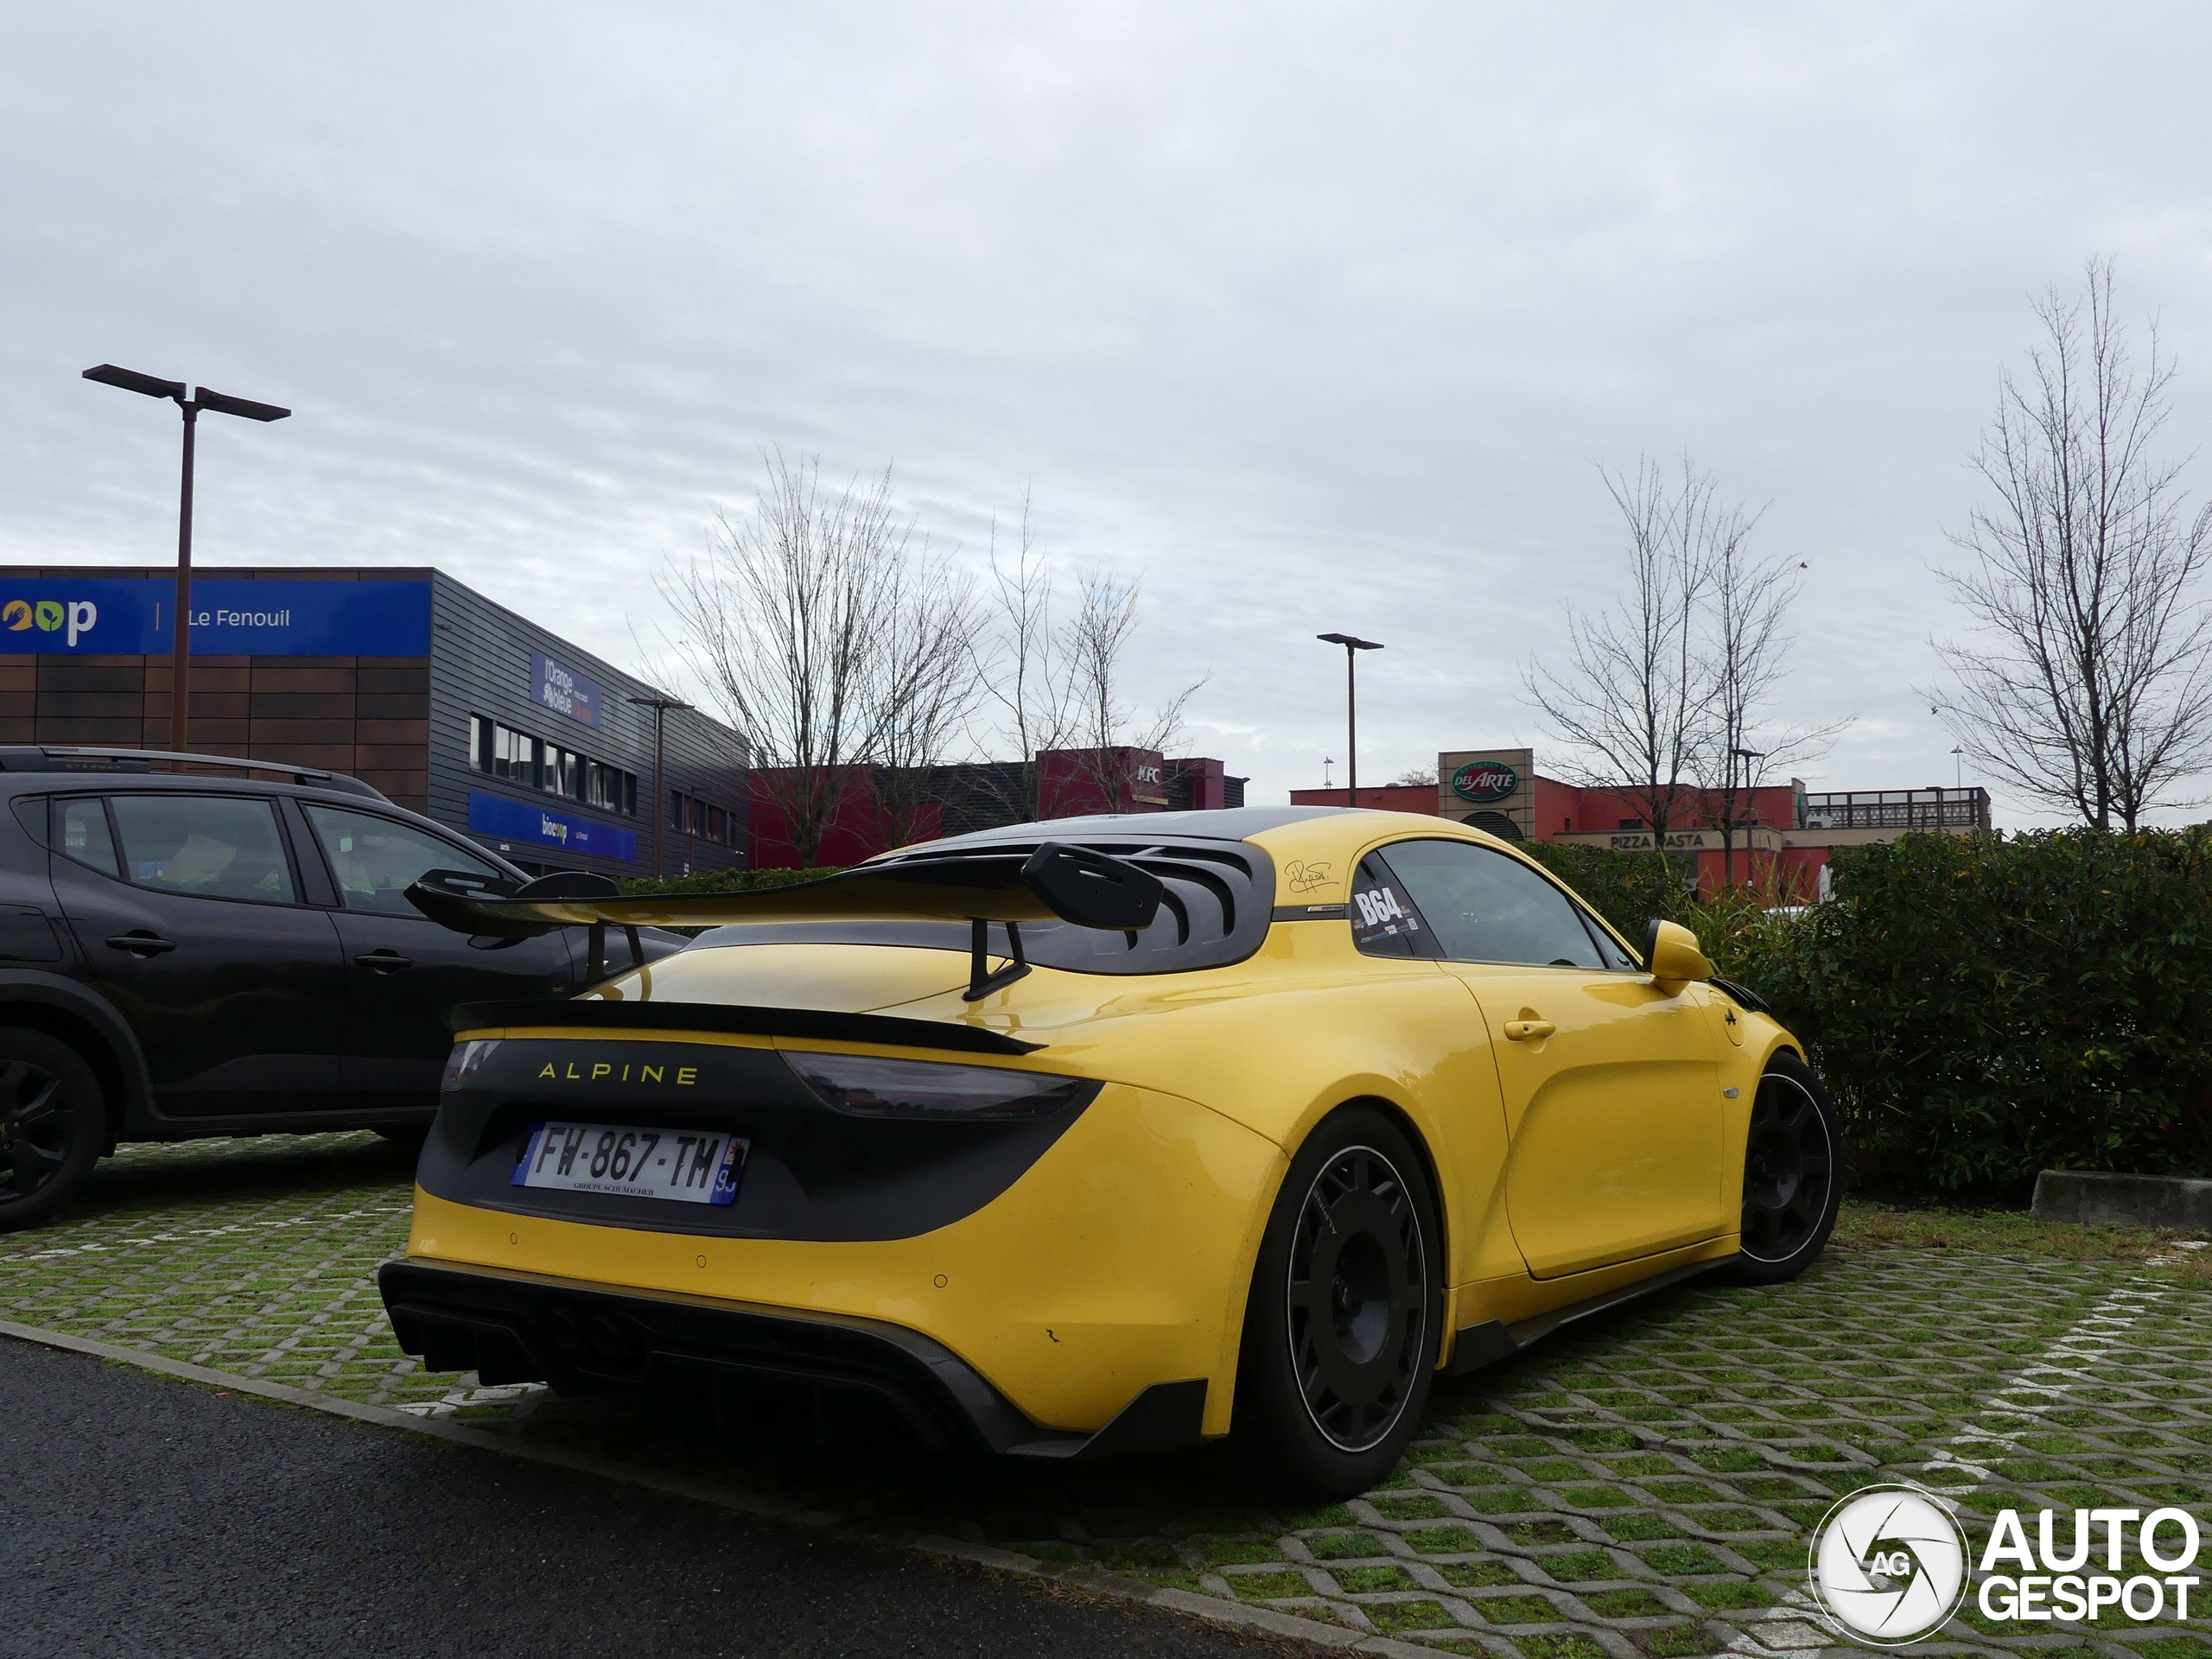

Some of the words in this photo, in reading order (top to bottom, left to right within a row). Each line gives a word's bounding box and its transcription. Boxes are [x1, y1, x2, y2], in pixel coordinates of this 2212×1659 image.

[189, 609, 211, 626] Le
[217, 609, 289, 626] Fenouil
[553, 687, 572, 715] bleue
[1136, 765, 1160, 784] KFC
[1611, 836, 1652, 849] PIZZA
[1657, 834, 1704, 848] ASTA
[1354, 887, 1403, 926] B64
[538, 1062, 698, 1086] ALPINE
[535, 1127, 720, 1189] FW-867-TM
[574, 1182, 603, 1192] GROUPE
[604, 1185, 655, 1196] SCHUMACHER
[1313, 1187, 1338, 1235] ALPINE
